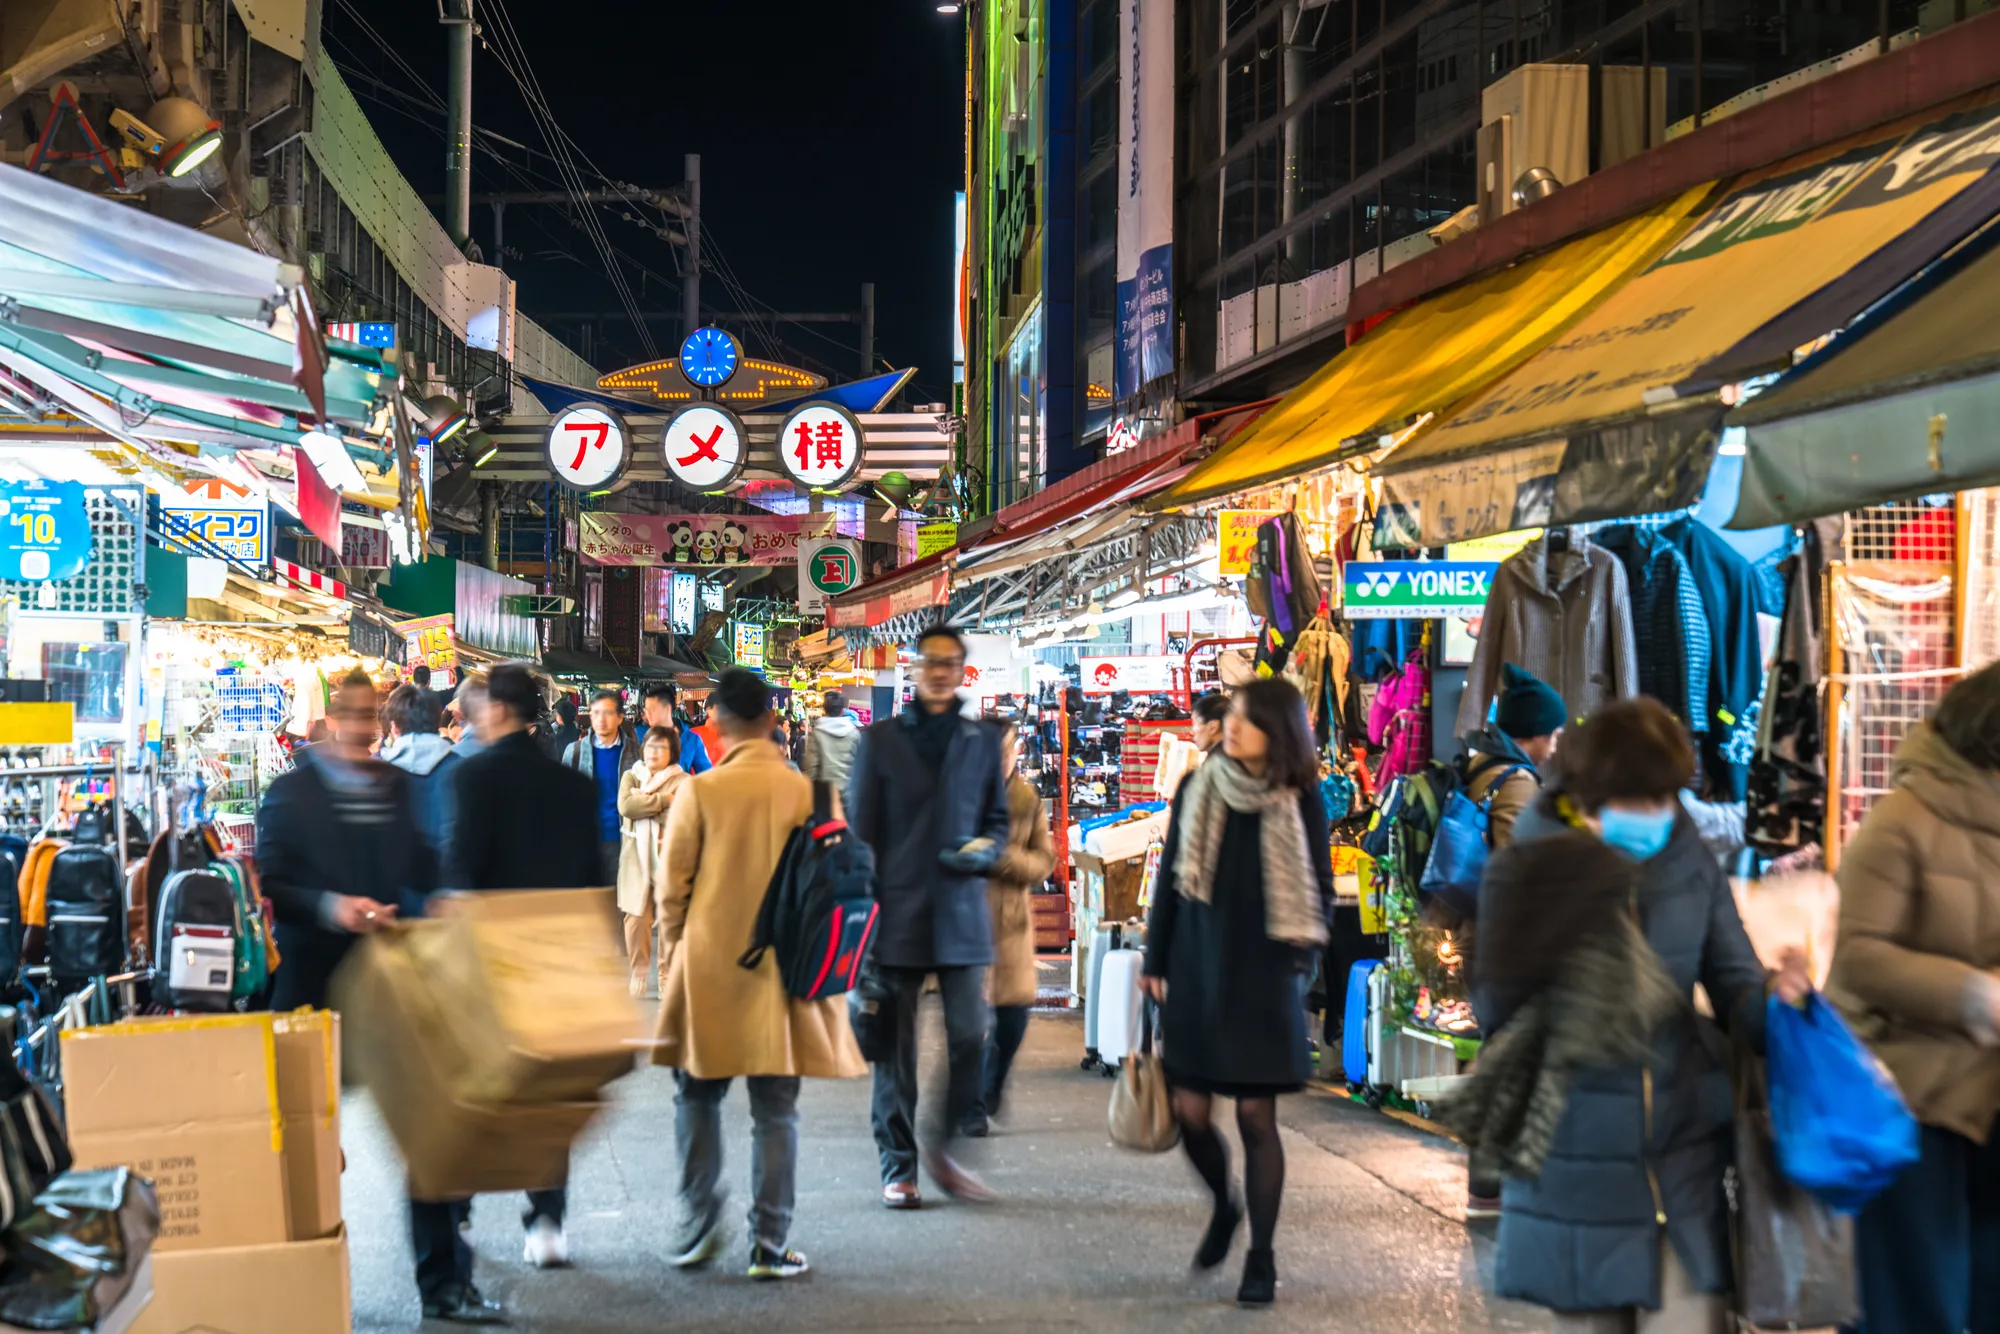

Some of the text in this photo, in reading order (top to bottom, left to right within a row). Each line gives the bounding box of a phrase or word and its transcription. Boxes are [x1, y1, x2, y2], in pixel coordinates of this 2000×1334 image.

[565, 421, 844, 471] アメ横
[18, 514, 55, 544] 10
[170, 514, 258, 537] ダイコク
[586, 543, 655, 555] 赤ちゃん誕生
[1406, 570, 1487, 596] YONEX
[427, 649, 454, 670] OFF
